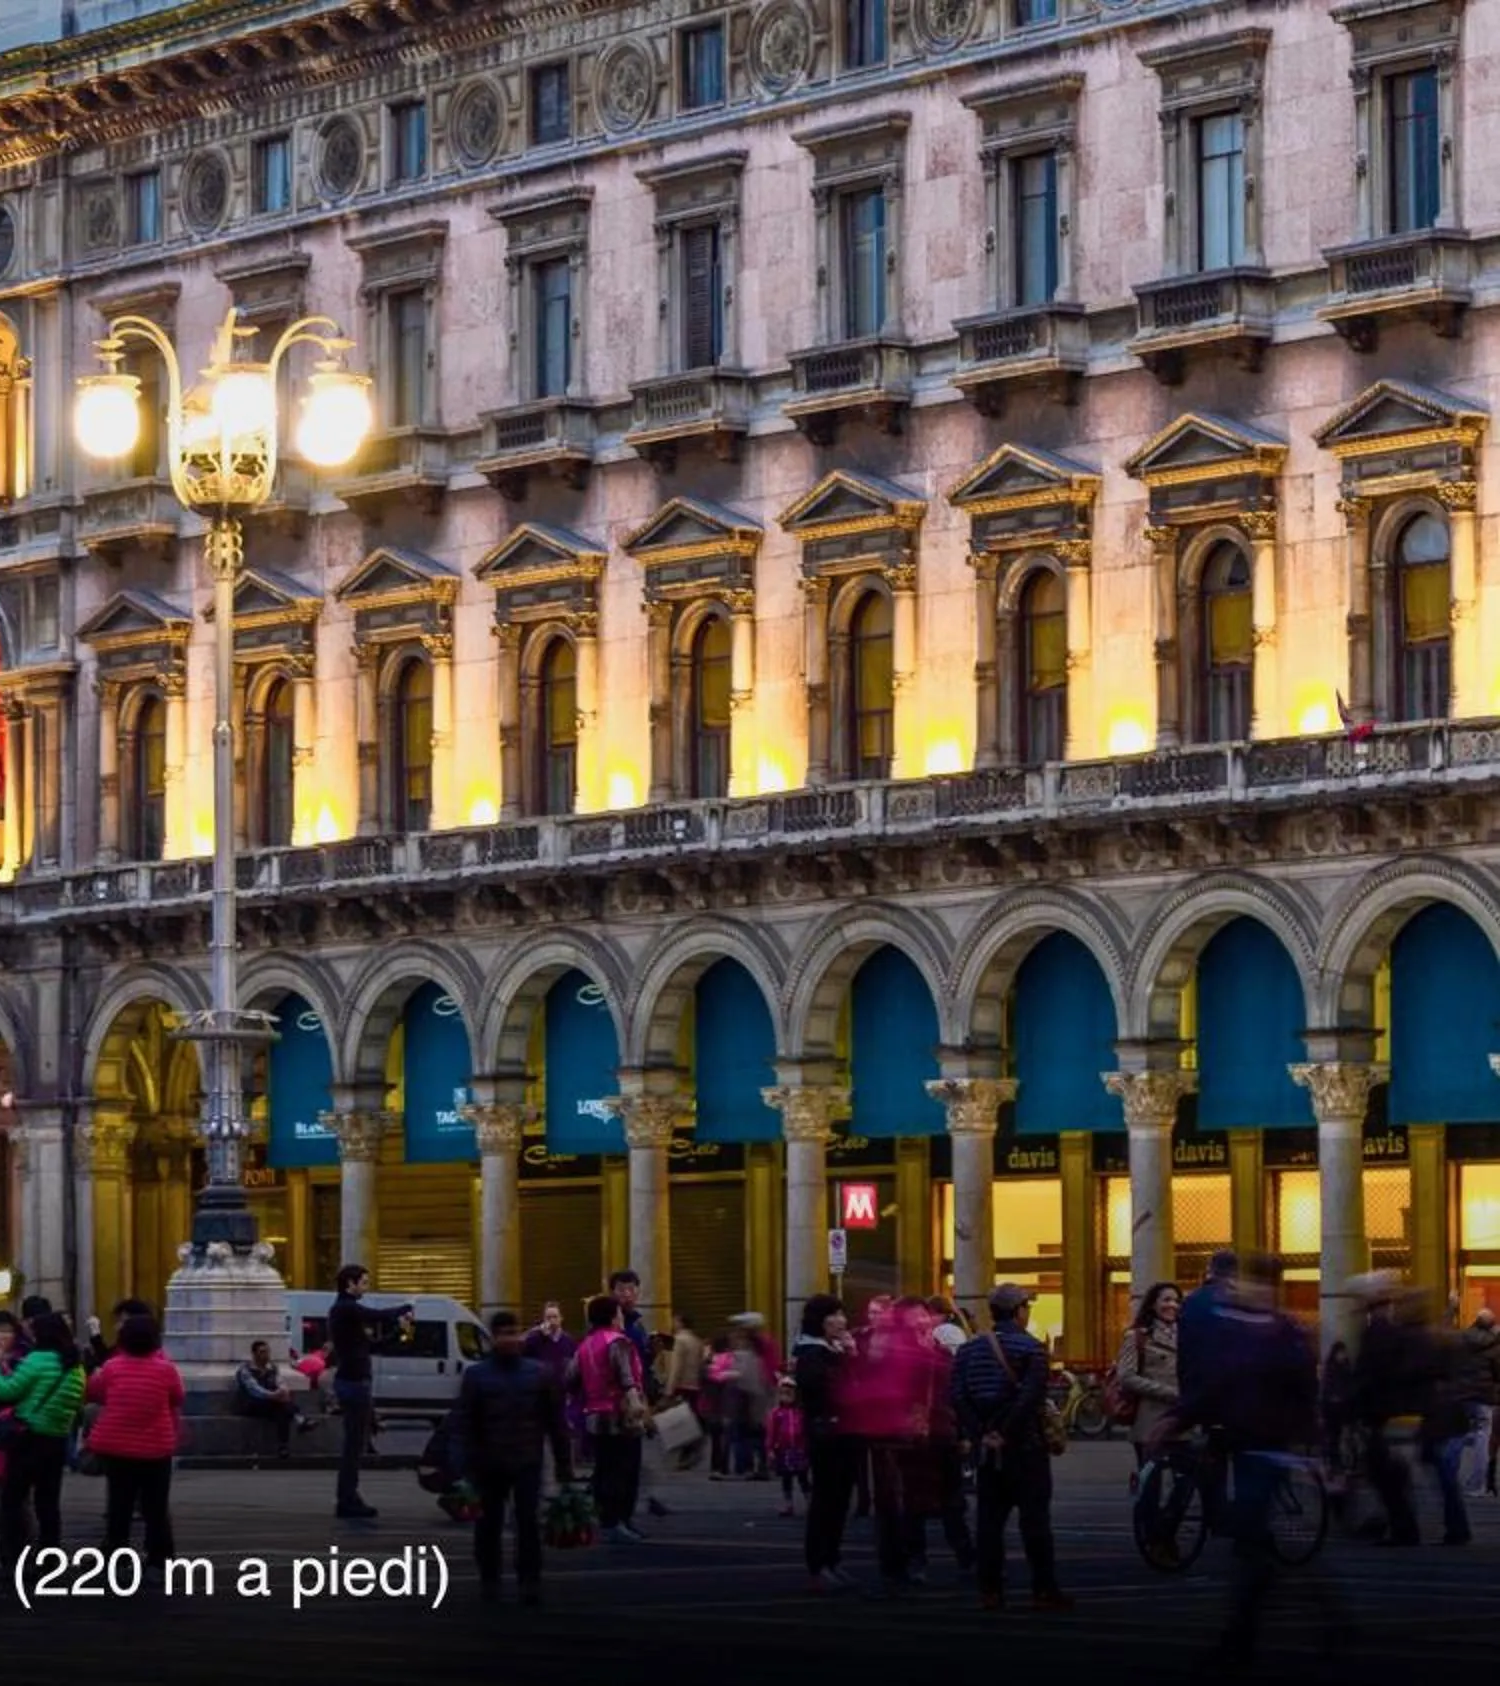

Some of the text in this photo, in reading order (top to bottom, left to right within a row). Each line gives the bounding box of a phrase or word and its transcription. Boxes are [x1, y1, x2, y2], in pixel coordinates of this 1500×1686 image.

[1174, 1140, 1224, 1163] davis
[1364, 1130, 1405, 1155] avis
[1008, 1145, 1055, 1168] davis
[845, 1192, 875, 1219] M
